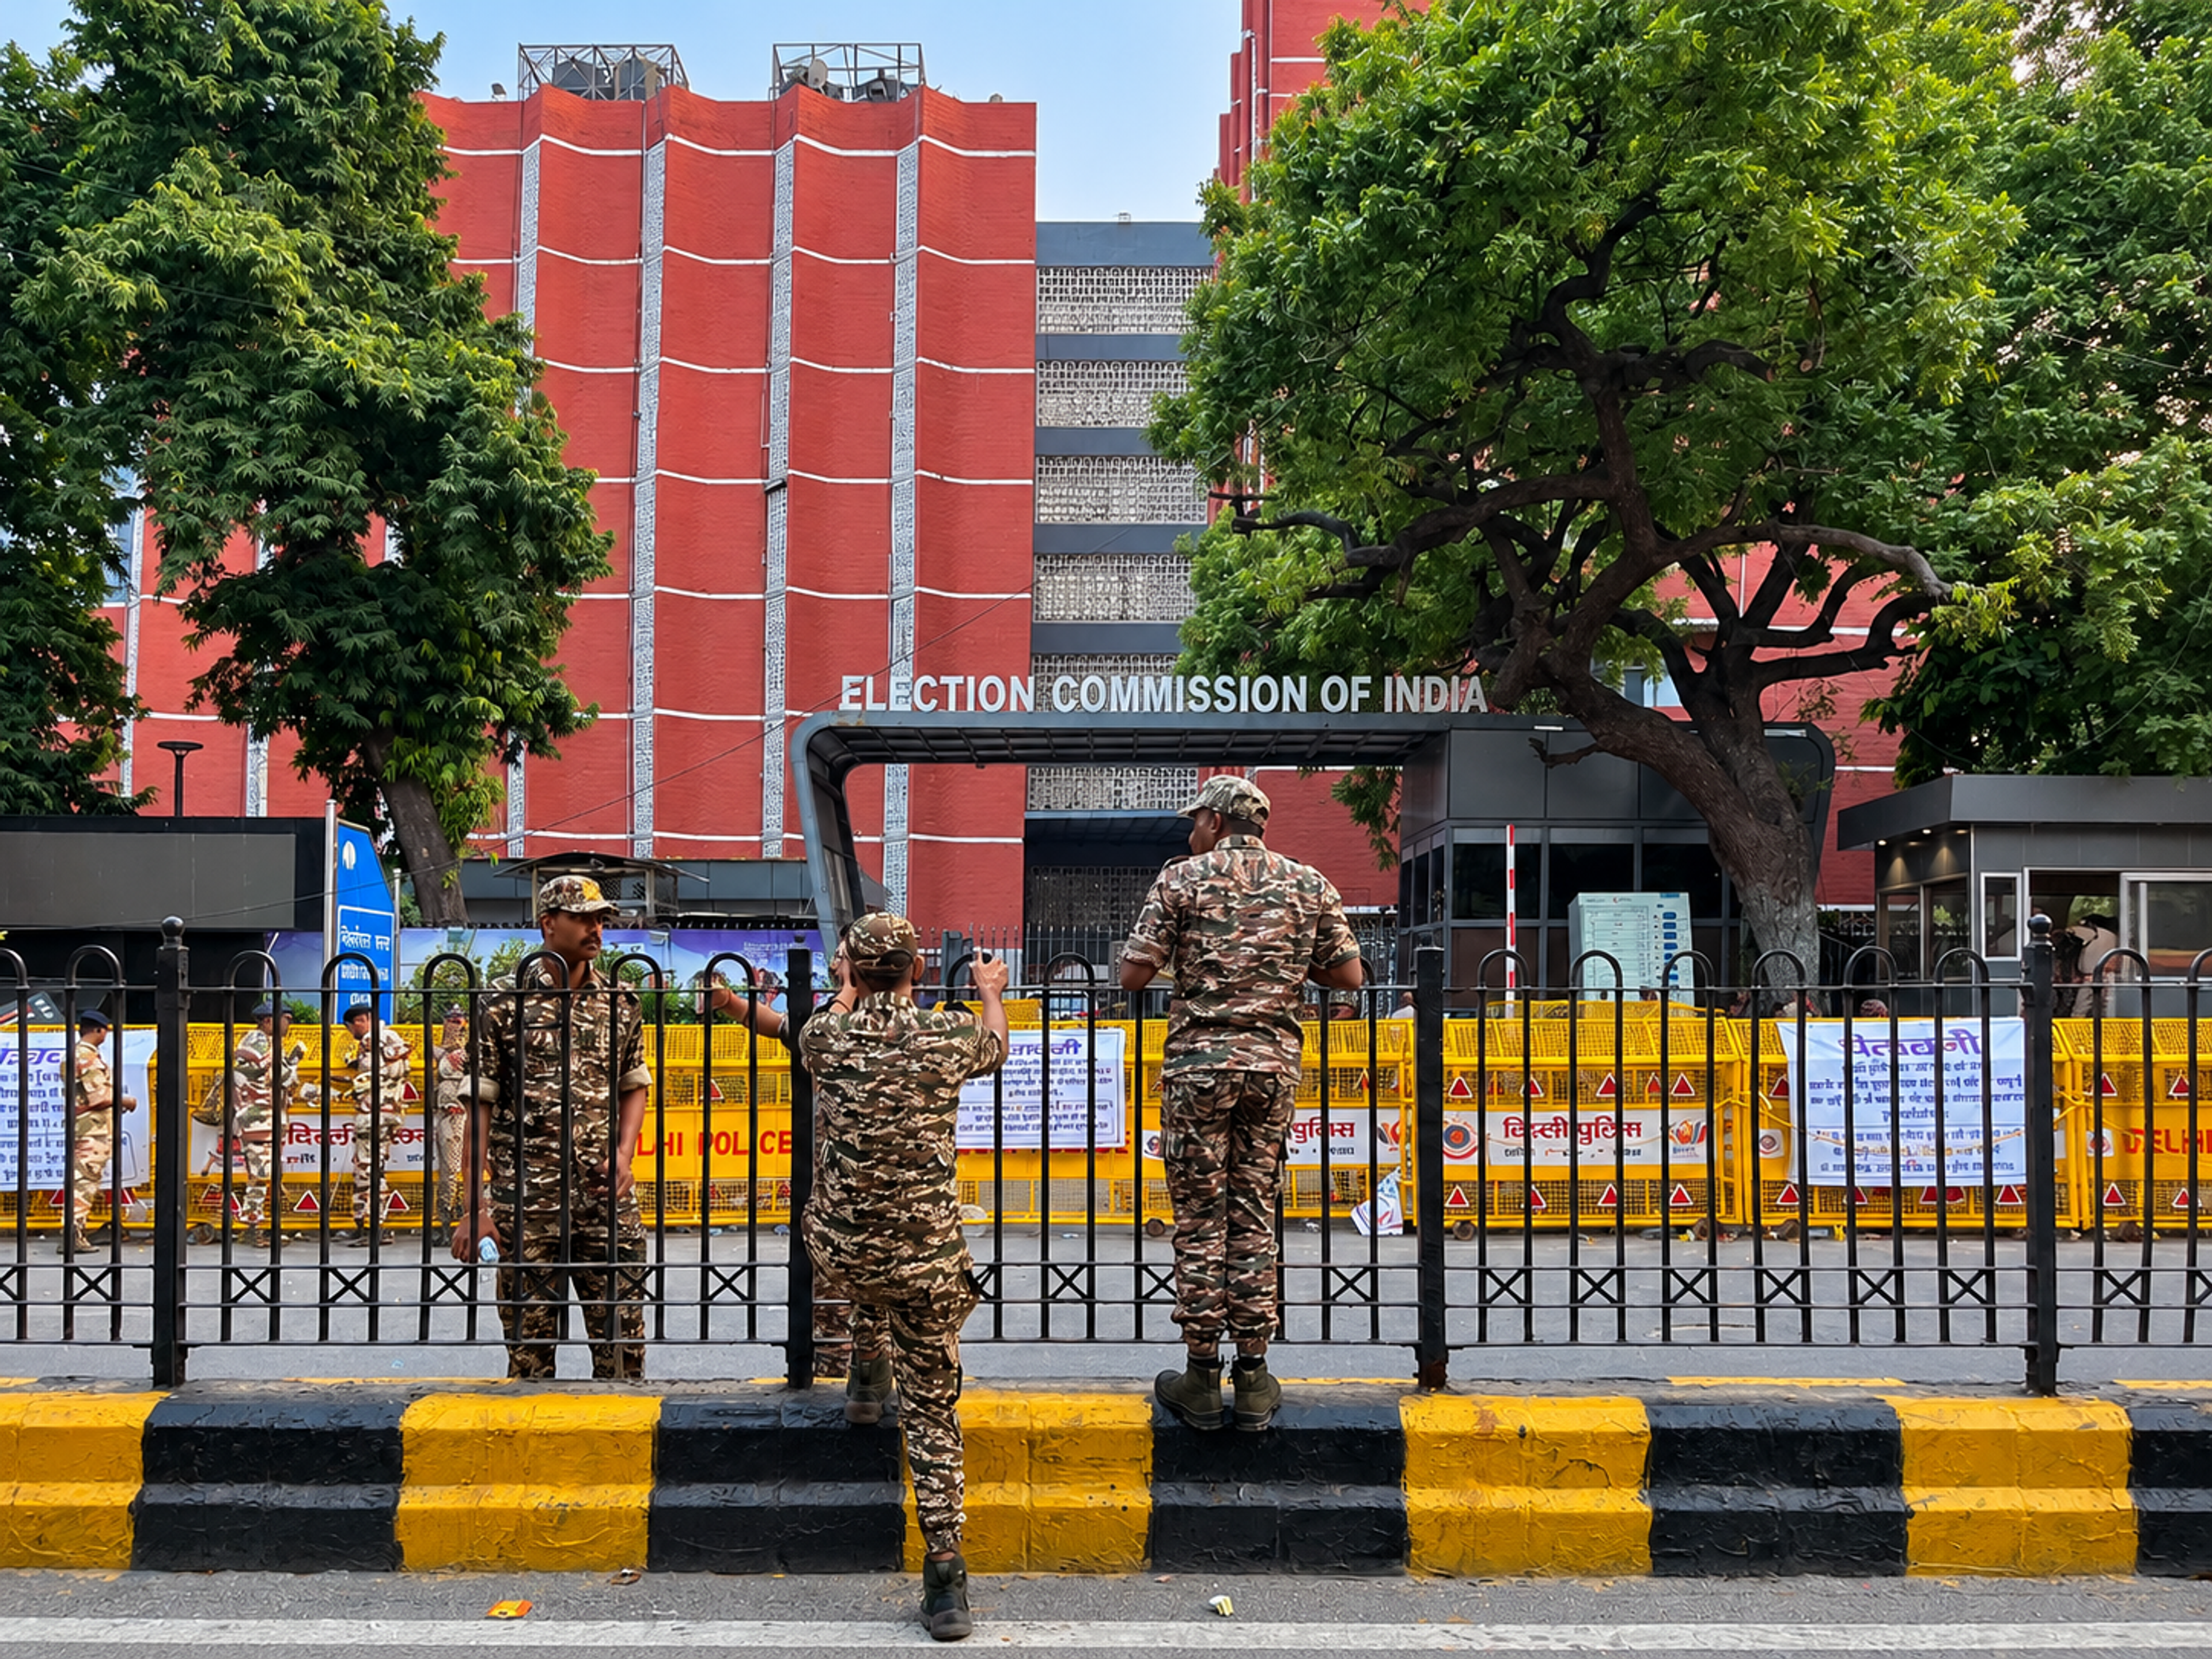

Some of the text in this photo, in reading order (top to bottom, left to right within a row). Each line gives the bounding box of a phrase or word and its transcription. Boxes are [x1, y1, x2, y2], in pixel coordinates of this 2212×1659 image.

[839, 675, 1488, 713] ELECTION COMMISSION OF INDIA
[637, 1131, 792, 1156] LHI POLICE
